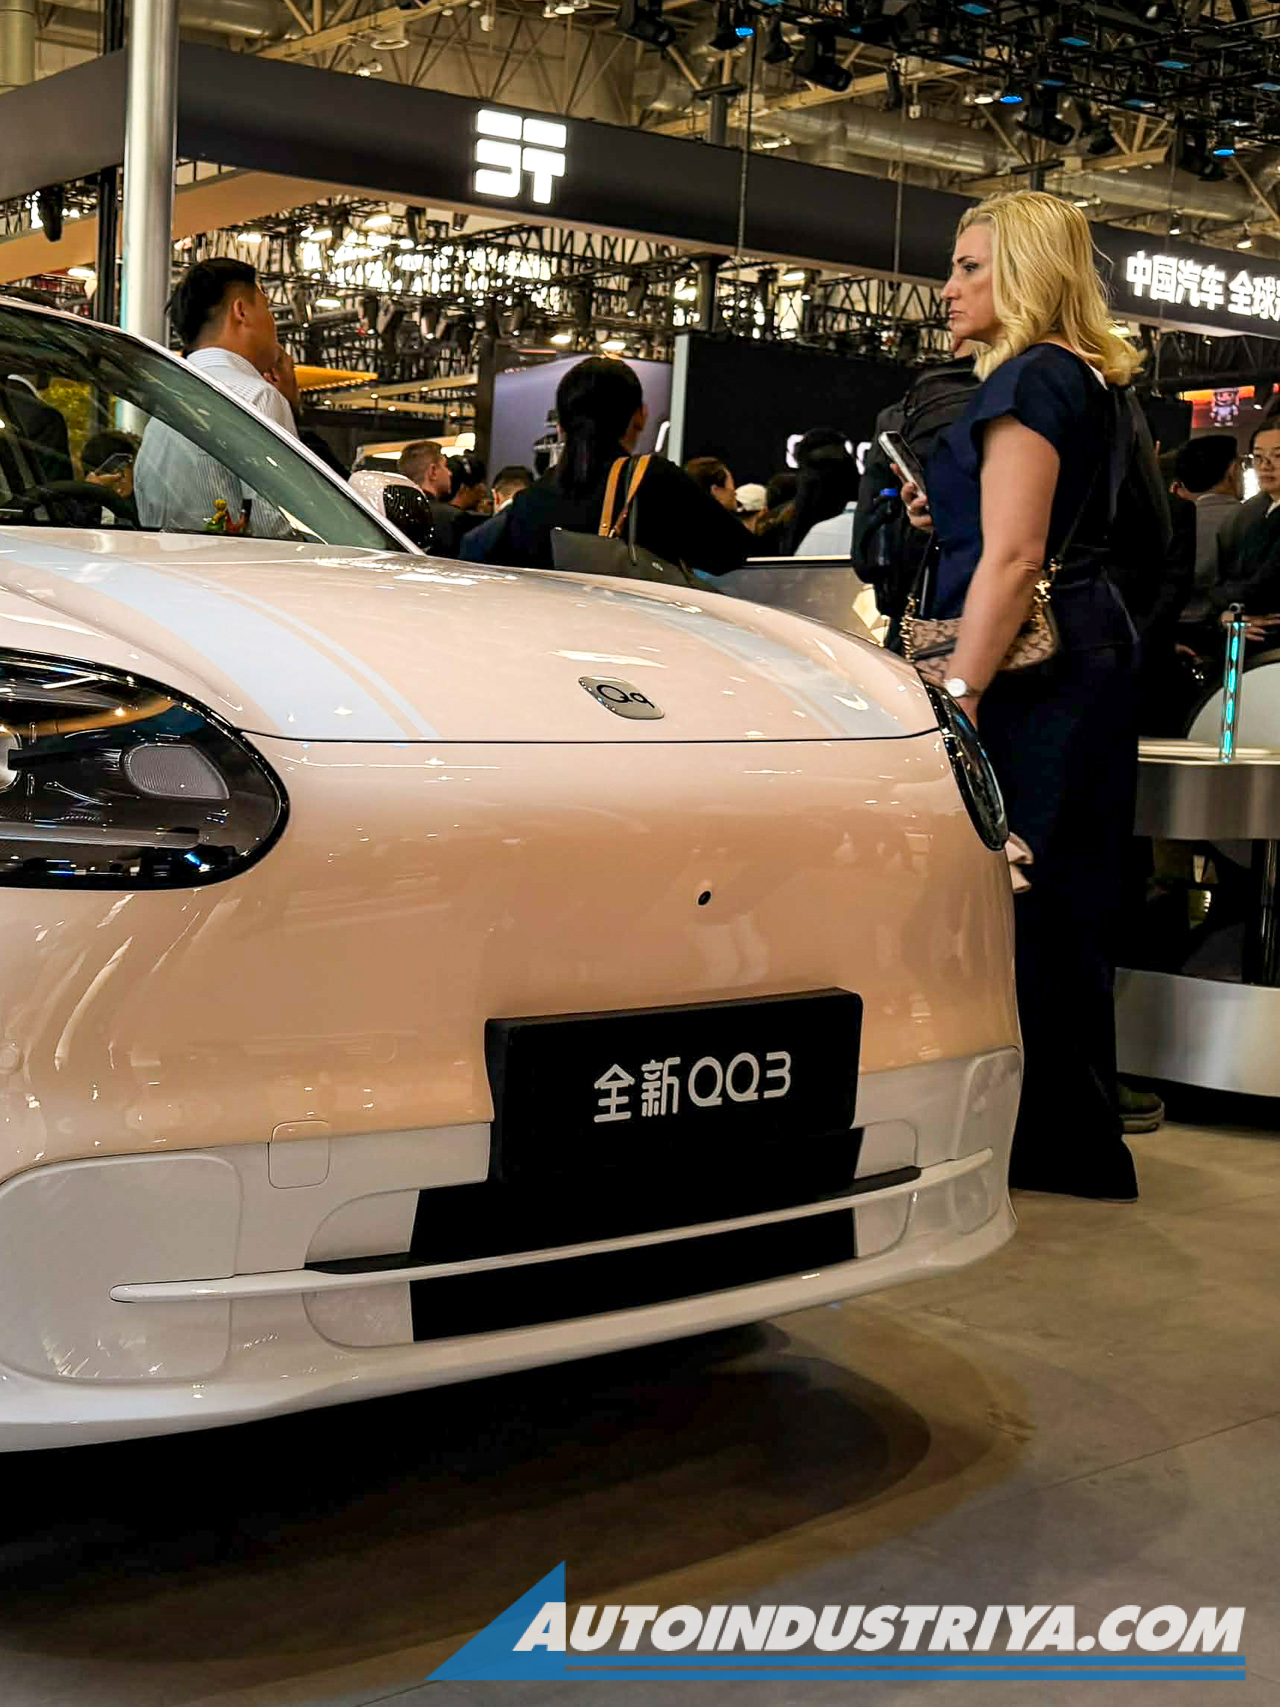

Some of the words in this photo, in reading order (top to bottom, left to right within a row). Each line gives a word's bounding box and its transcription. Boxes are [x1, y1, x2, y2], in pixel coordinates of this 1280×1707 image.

[1126, 250, 1226, 311] 中国汽车
[1227, 270, 1280, 322] 全球
